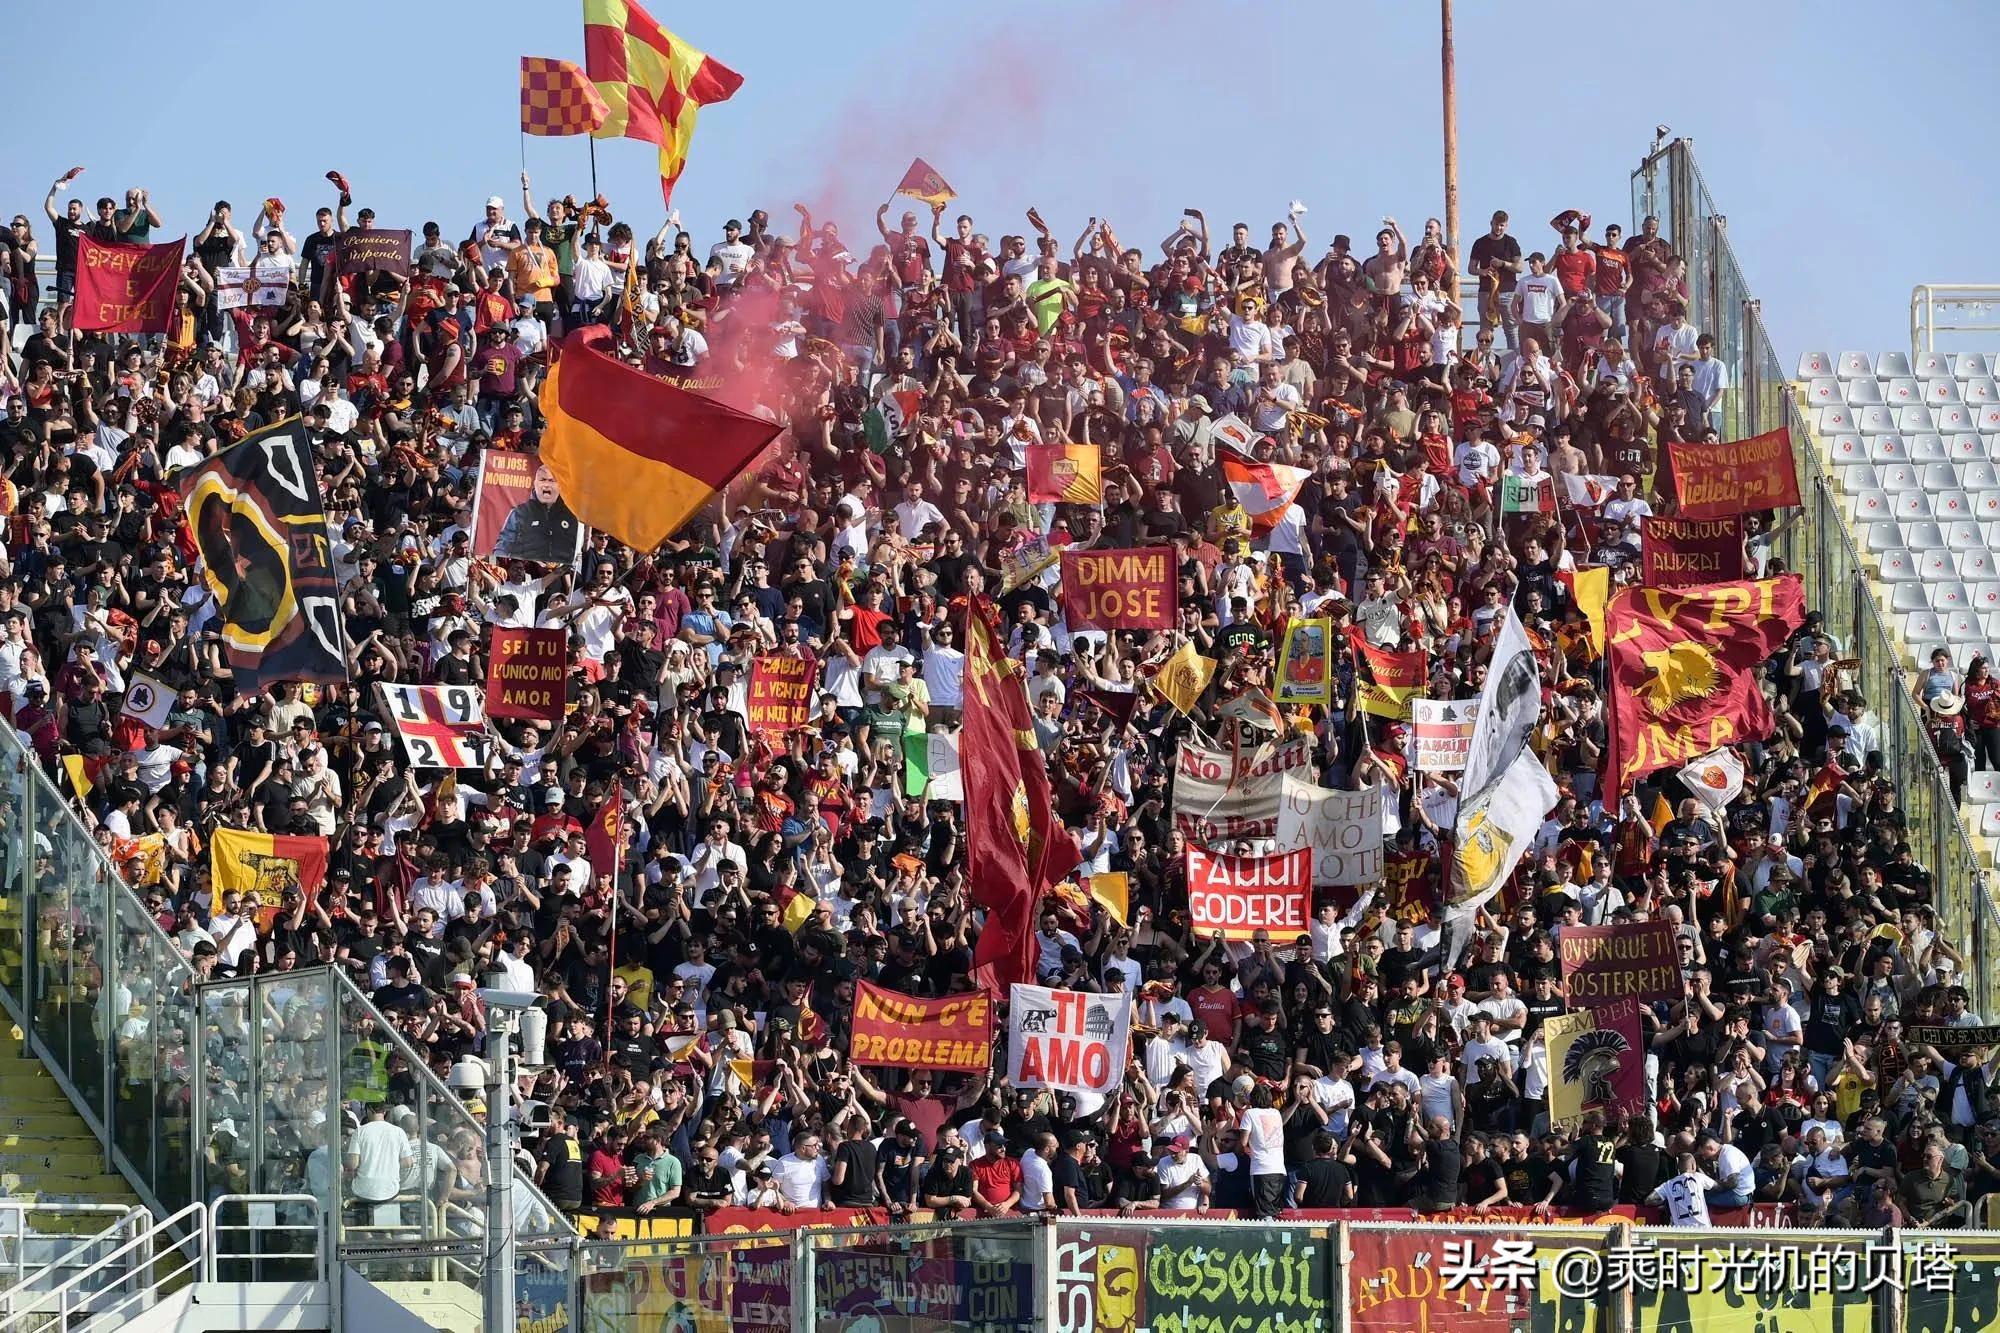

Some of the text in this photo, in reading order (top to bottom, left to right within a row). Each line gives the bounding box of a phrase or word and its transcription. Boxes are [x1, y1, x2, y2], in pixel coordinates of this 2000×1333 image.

[127, 280, 136, 297] E
[485, 472, 532, 489] MOURINHO
[1507, 483, 1551, 503] ROMA
[1078, 555, 1165, 586] DIMMI
[502, 640, 557, 656] SEI TU
[1229, 633, 1255, 647] GCDS
[493, 663, 562, 681] L'UNICO MIO
[502, 691, 551, 705] AMOR
[753, 681, 809, 699] IL VENTO
[1178, 746, 1222, 781] No
[1287, 784, 1379, 822] IO CHE
[1294, 820, 1363, 850] AMO
[1353, 848, 1383, 878] TE
[1190, 891, 1304, 926] GODERE
[1563, 931, 1671, 963] OVUNQUE TI
[856, 992, 928, 1027] NUN
[1051, 993, 1087, 1036] TI
[1199, 1002, 1225, 1010] Barilla
[1547, 998, 1635, 1038] SEMPER
[852, 1033, 990, 1067] PROBLEMA
[1019, 1035, 1110, 1090] AMO
[968, 1285, 1018, 1322] CON
